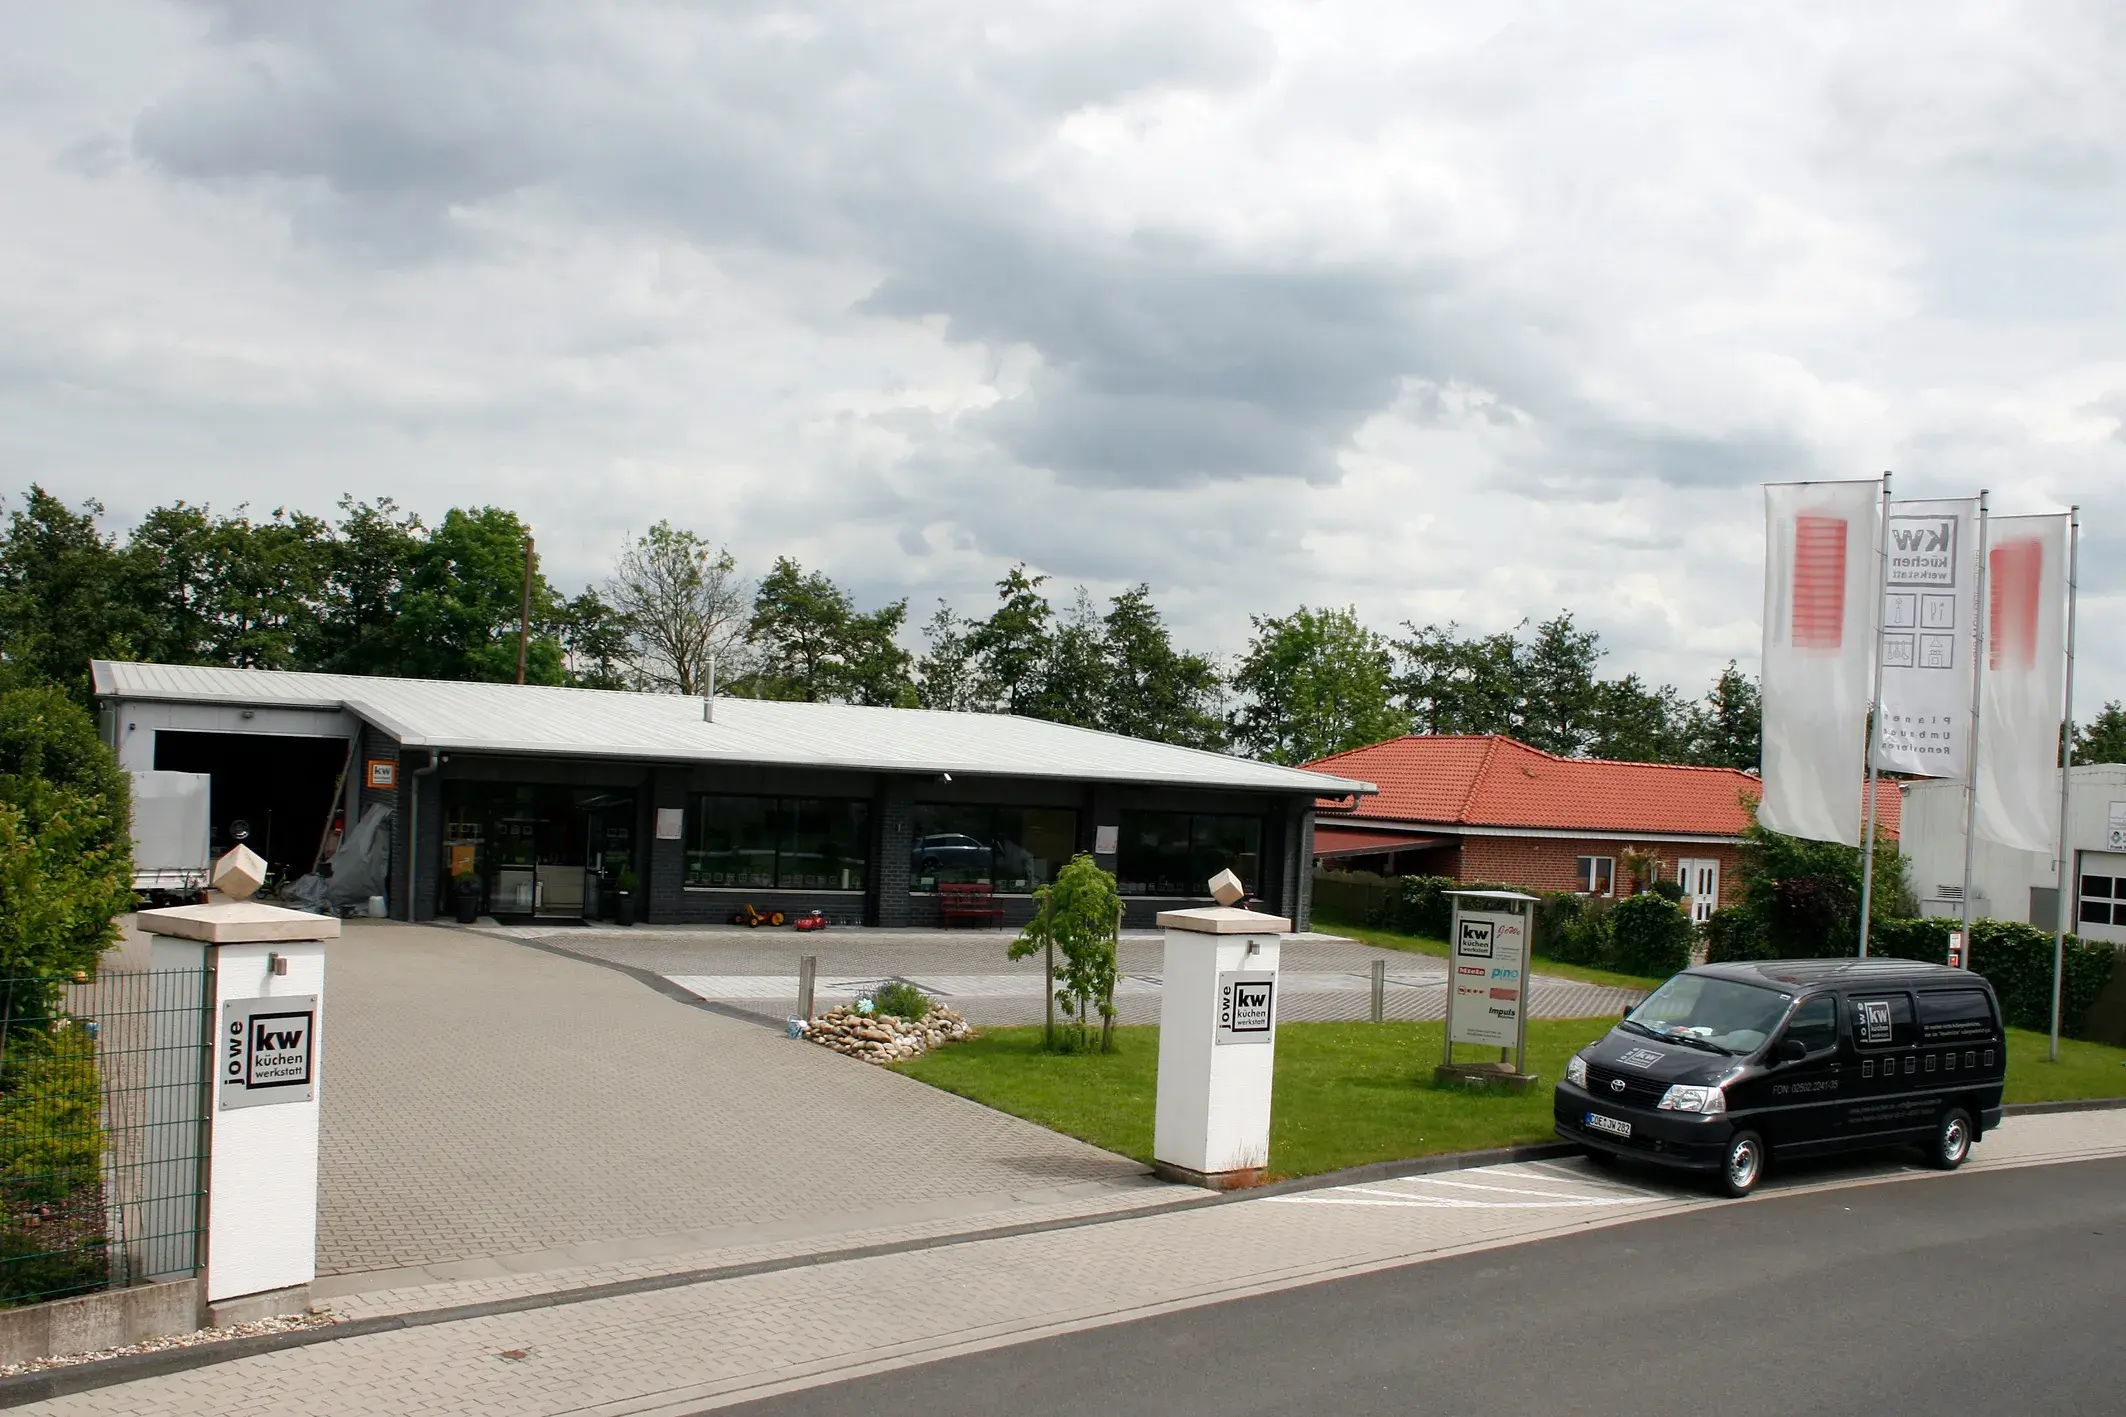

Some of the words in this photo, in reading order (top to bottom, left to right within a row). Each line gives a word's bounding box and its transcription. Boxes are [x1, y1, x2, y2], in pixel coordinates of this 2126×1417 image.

[1463, 925, 1489, 940] kw
[1459, 967, 1485, 976] Miele
[1491, 967, 1519, 979] pino
[1238, 989, 1266, 1007] kw
[1219, 986, 1231, 1029] jowe
[1237, 1009, 1266, 1018] küchen
[1489, 1007, 1516, 1016] Impuls
[1868, 1006, 1888, 1023] kw
[256, 1024, 303, 1051] kw
[224, 1021, 245, 1086] jowe
[255, 1053, 303, 1067] küchen
[255, 1067, 303, 1078] werkstatt
